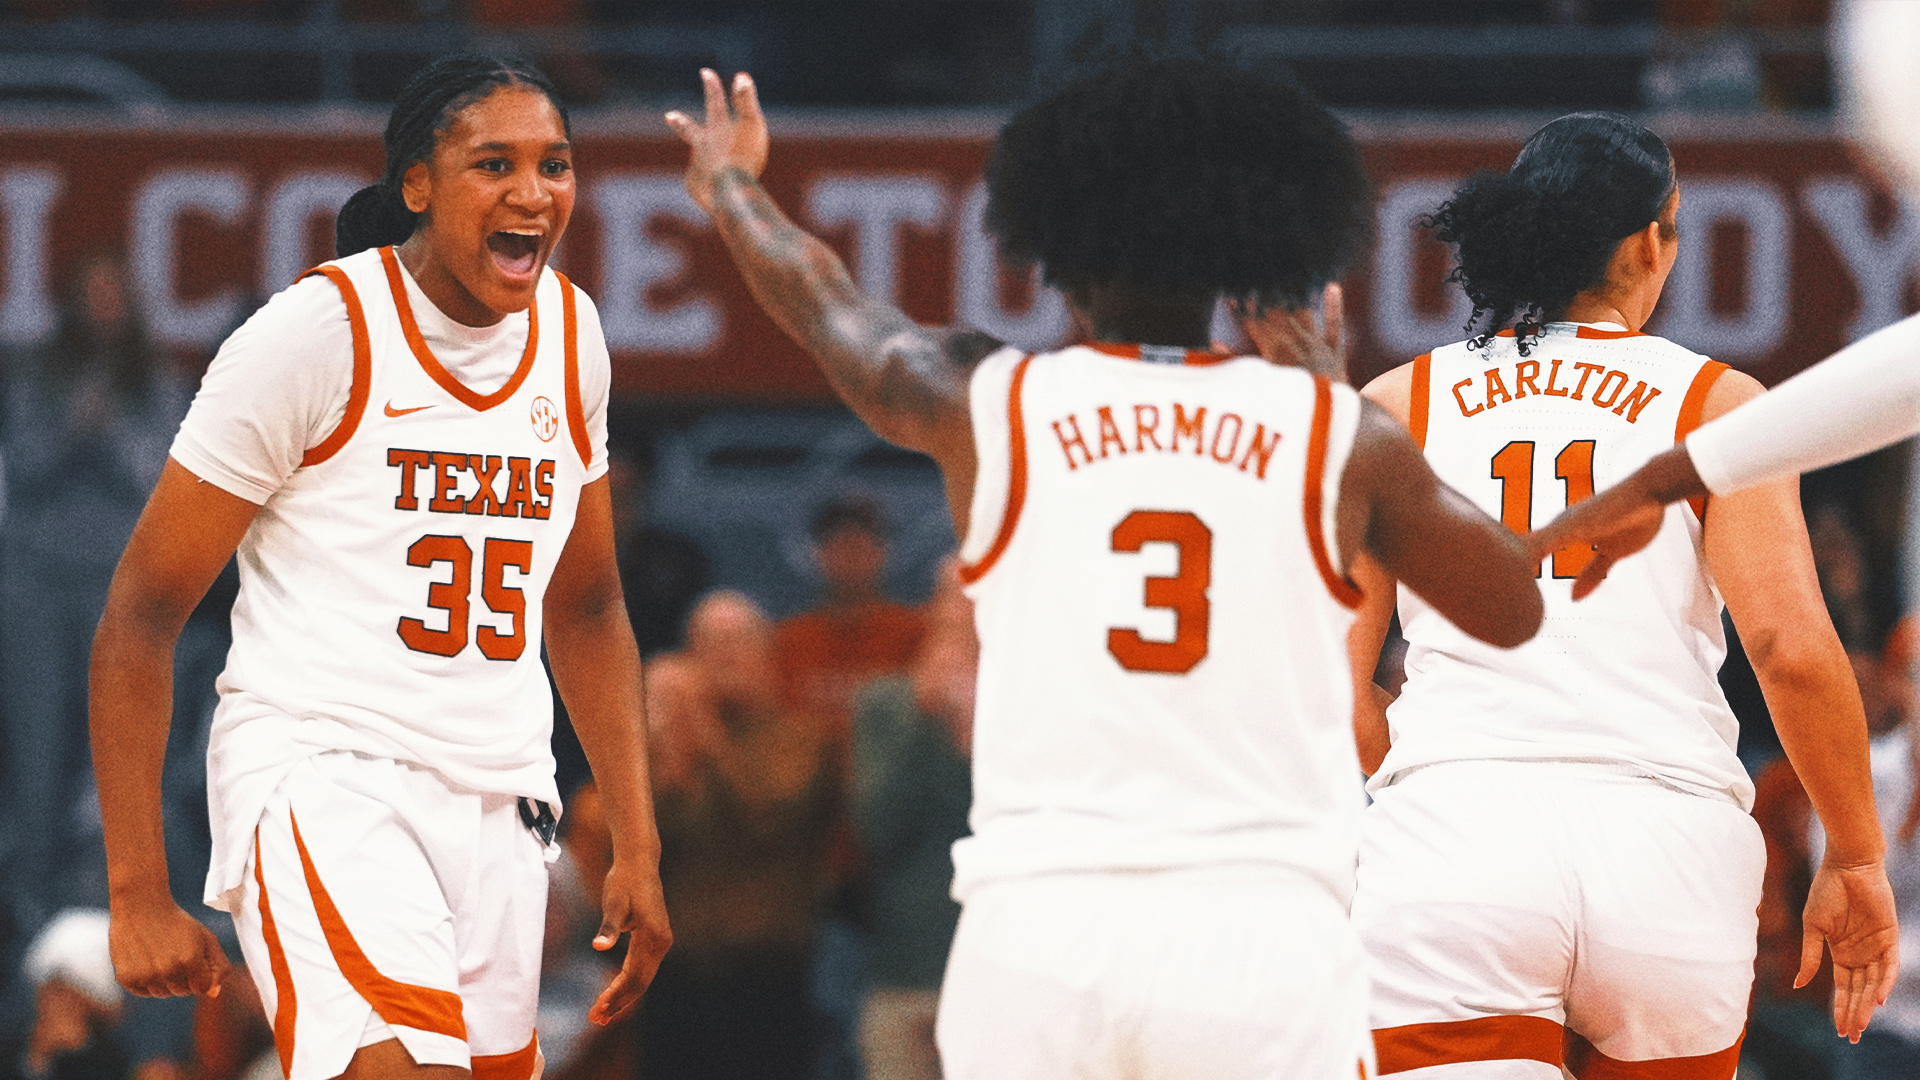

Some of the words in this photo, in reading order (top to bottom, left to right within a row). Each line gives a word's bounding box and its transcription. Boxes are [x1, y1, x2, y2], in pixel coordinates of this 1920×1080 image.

[531, 397, 558, 441] SEC
[1452, 359, 1662, 424] CARLTON
[1051, 402, 1282, 480] HARMON
[387, 448, 556, 520] TEXAS
[1491, 440, 1606, 579] 11
[397, 534, 533, 661] 35
[1107, 509, 1213, 675] 3
